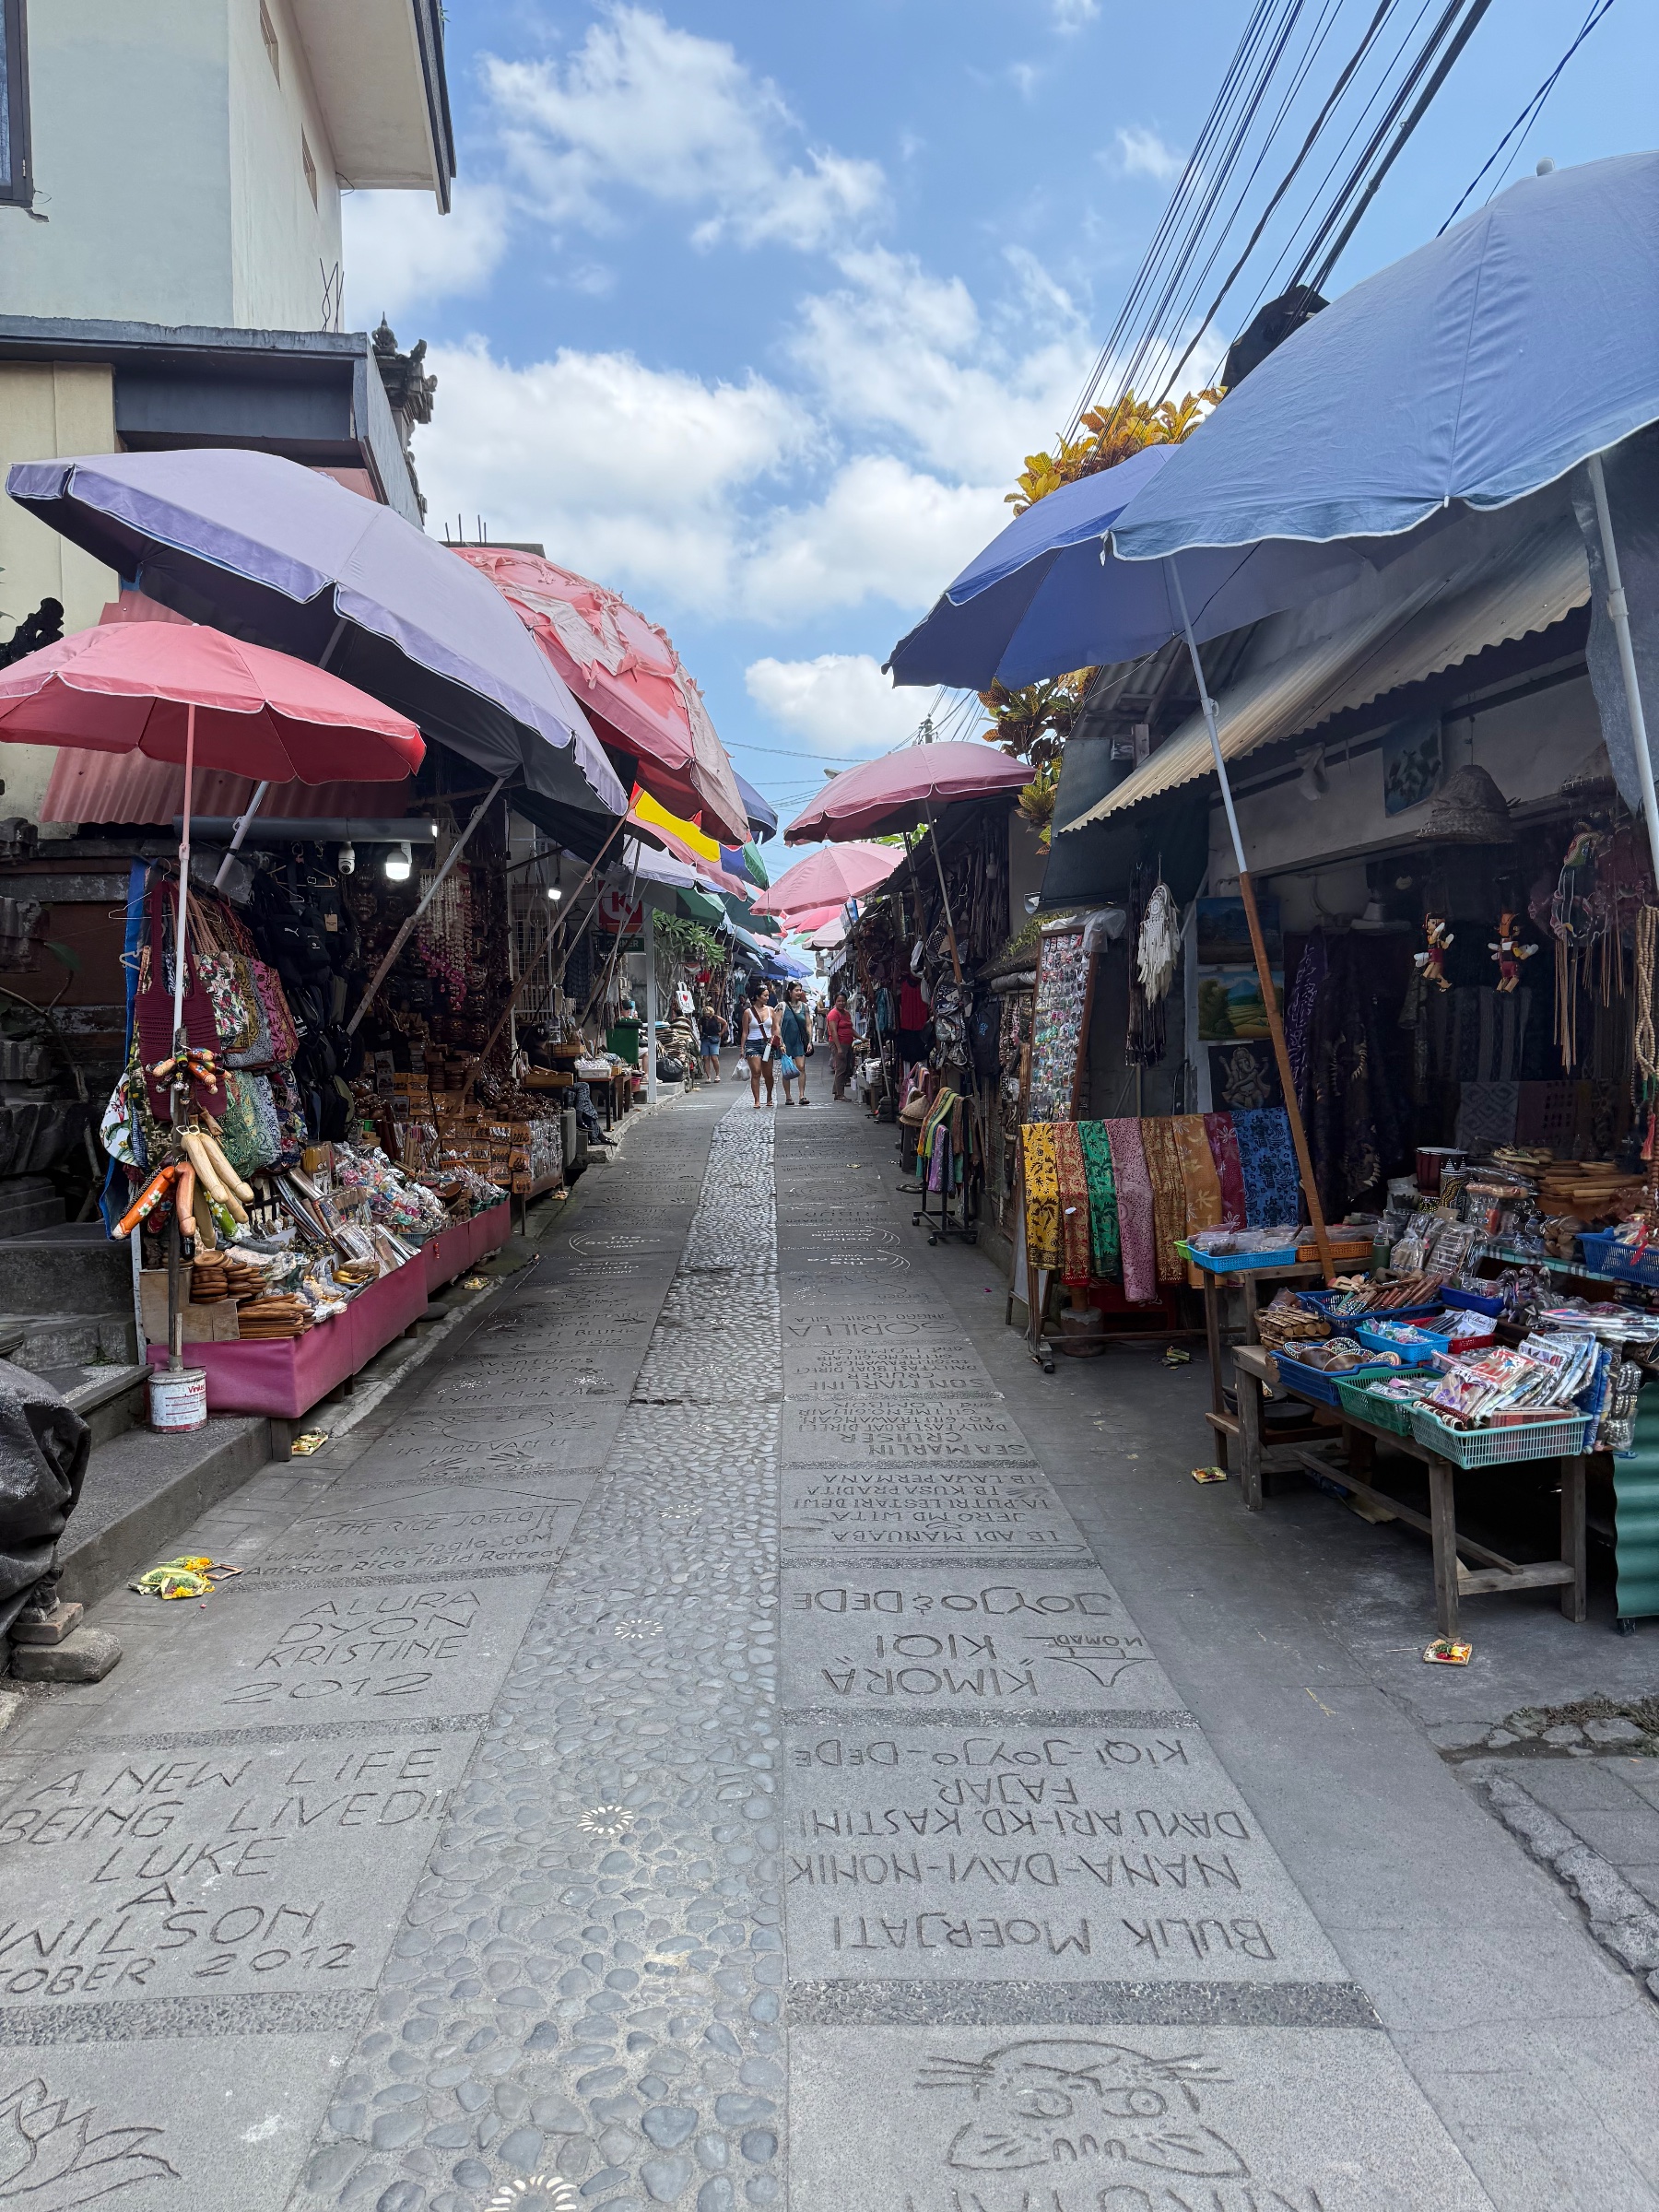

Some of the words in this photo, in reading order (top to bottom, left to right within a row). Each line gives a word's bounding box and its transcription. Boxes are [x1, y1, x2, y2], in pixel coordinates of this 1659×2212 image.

[786, 1322, 959, 1337] GORILLA
[838, 1432, 962, 1443] CRUISER
[868, 1444, 970, 1456] MARLIN
[973, 1444, 1026, 1455] SEA
[334, 1522, 382, 1535] THE
[382, 1517, 449, 1532] RICE
[830, 1531, 964, 1543] MANUABA
[973, 1531, 1015, 1543] ADI
[300, 1590, 481, 1618] ALURA
[276, 1610, 478, 1645] DYON
[253, 1634, 469, 1670] KRISTINE
[220, 1672, 433, 1705] 2012
[820, 1666, 1038, 1698] KIMORA
[25, 1769, 86, 1801] A
[101, 1759, 253, 1797] NEW
[285, 1747, 442, 1787] LIFE
[931, 1773, 1078, 1806] FAJAR
[1135, 1809, 1251, 1841] DAYU
[92, 1836, 283, 1884] LUKE
[832, 1912, 1091, 1956] MOERJATI
[194, 1941, 357, 1979] 2012
